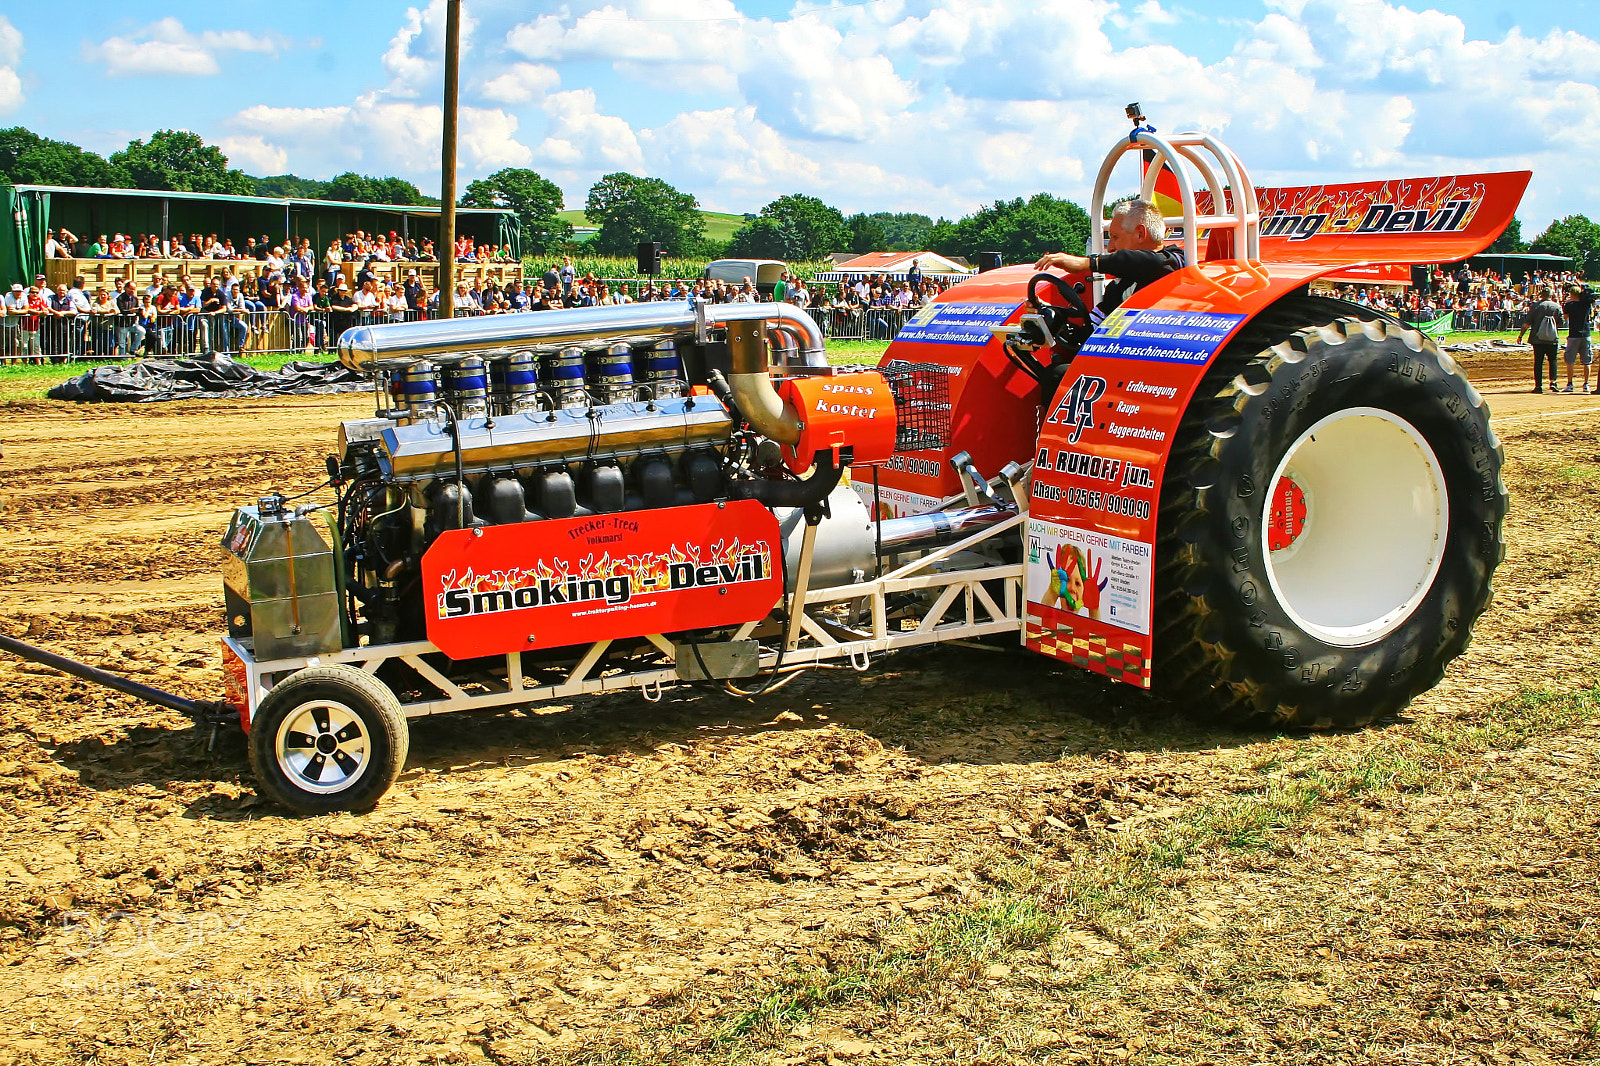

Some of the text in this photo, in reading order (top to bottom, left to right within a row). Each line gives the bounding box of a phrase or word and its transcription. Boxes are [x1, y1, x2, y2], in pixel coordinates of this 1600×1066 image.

[1356, 200, 1472, 232] Devil
[941, 305, 1014, 318] Hendrik Hilbring
[1136, 313, 1238, 331] Hendrik Hilbring
[898, 331, 990, 343] www.hh-maschinenbau.de
[1124, 328, 1172, 339] Maschinenbau
[1172, 332, 1195, 341] GmbH
[1210, 335, 1223, 343] KG
[1081, 342, 1209, 361] www.hh-maschinenbau.de
[1387, 350, 1427, 384] ALL
[822, 383, 875, 396] spass
[1126, 381, 1178, 398] Erdbewegung
[815, 399, 878, 419] kostet
[1116, 400, 1141, 415] Raupe
[1108, 422, 1166, 442] Baggerarbeiten
[1036, 447, 1155, 489] A. RUHOFF jun.
[1032, 480, 1061, 502] Ahaus
[1285, 490, 1293, 535] Smoking
[568, 519, 606, 540] Trecker
[614, 517, 640, 533] Treck
[1029, 522, 1149, 558] AUCH WIR SPIELEN GERNE MIT FARBEN
[445, 573, 631, 618] Smoking
[669, 553, 767, 590] Devil
